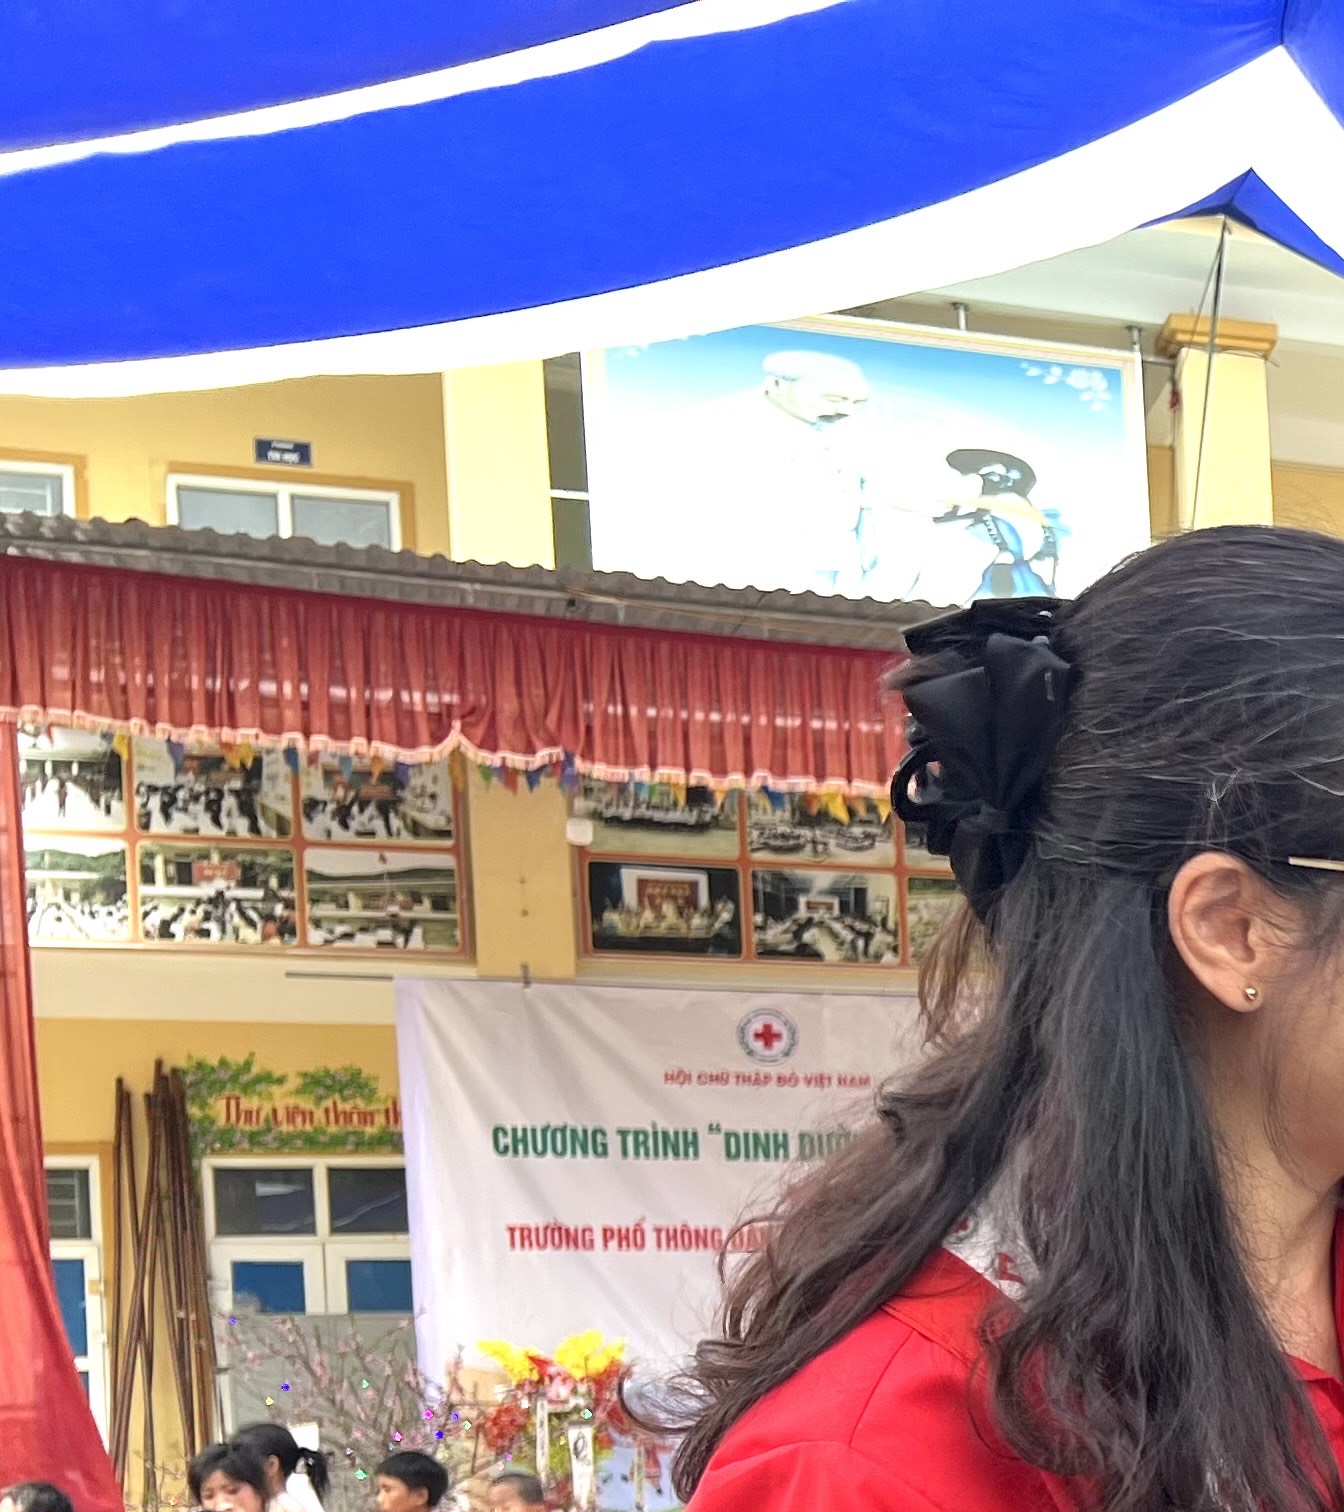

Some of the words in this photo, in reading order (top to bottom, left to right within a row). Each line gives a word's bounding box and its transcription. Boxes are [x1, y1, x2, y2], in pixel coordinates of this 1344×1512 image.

[837, 1073, 871, 1088] NAM
[492, 1121, 609, 1160] CHƯƠNG
[616, 1120, 700, 1161] TRÌNH
[506, 1217, 595, 1252] TRƯỜNG
[602, 1214, 646, 1252] PHỐ
[653, 1217, 723, 1252] THÔNG
